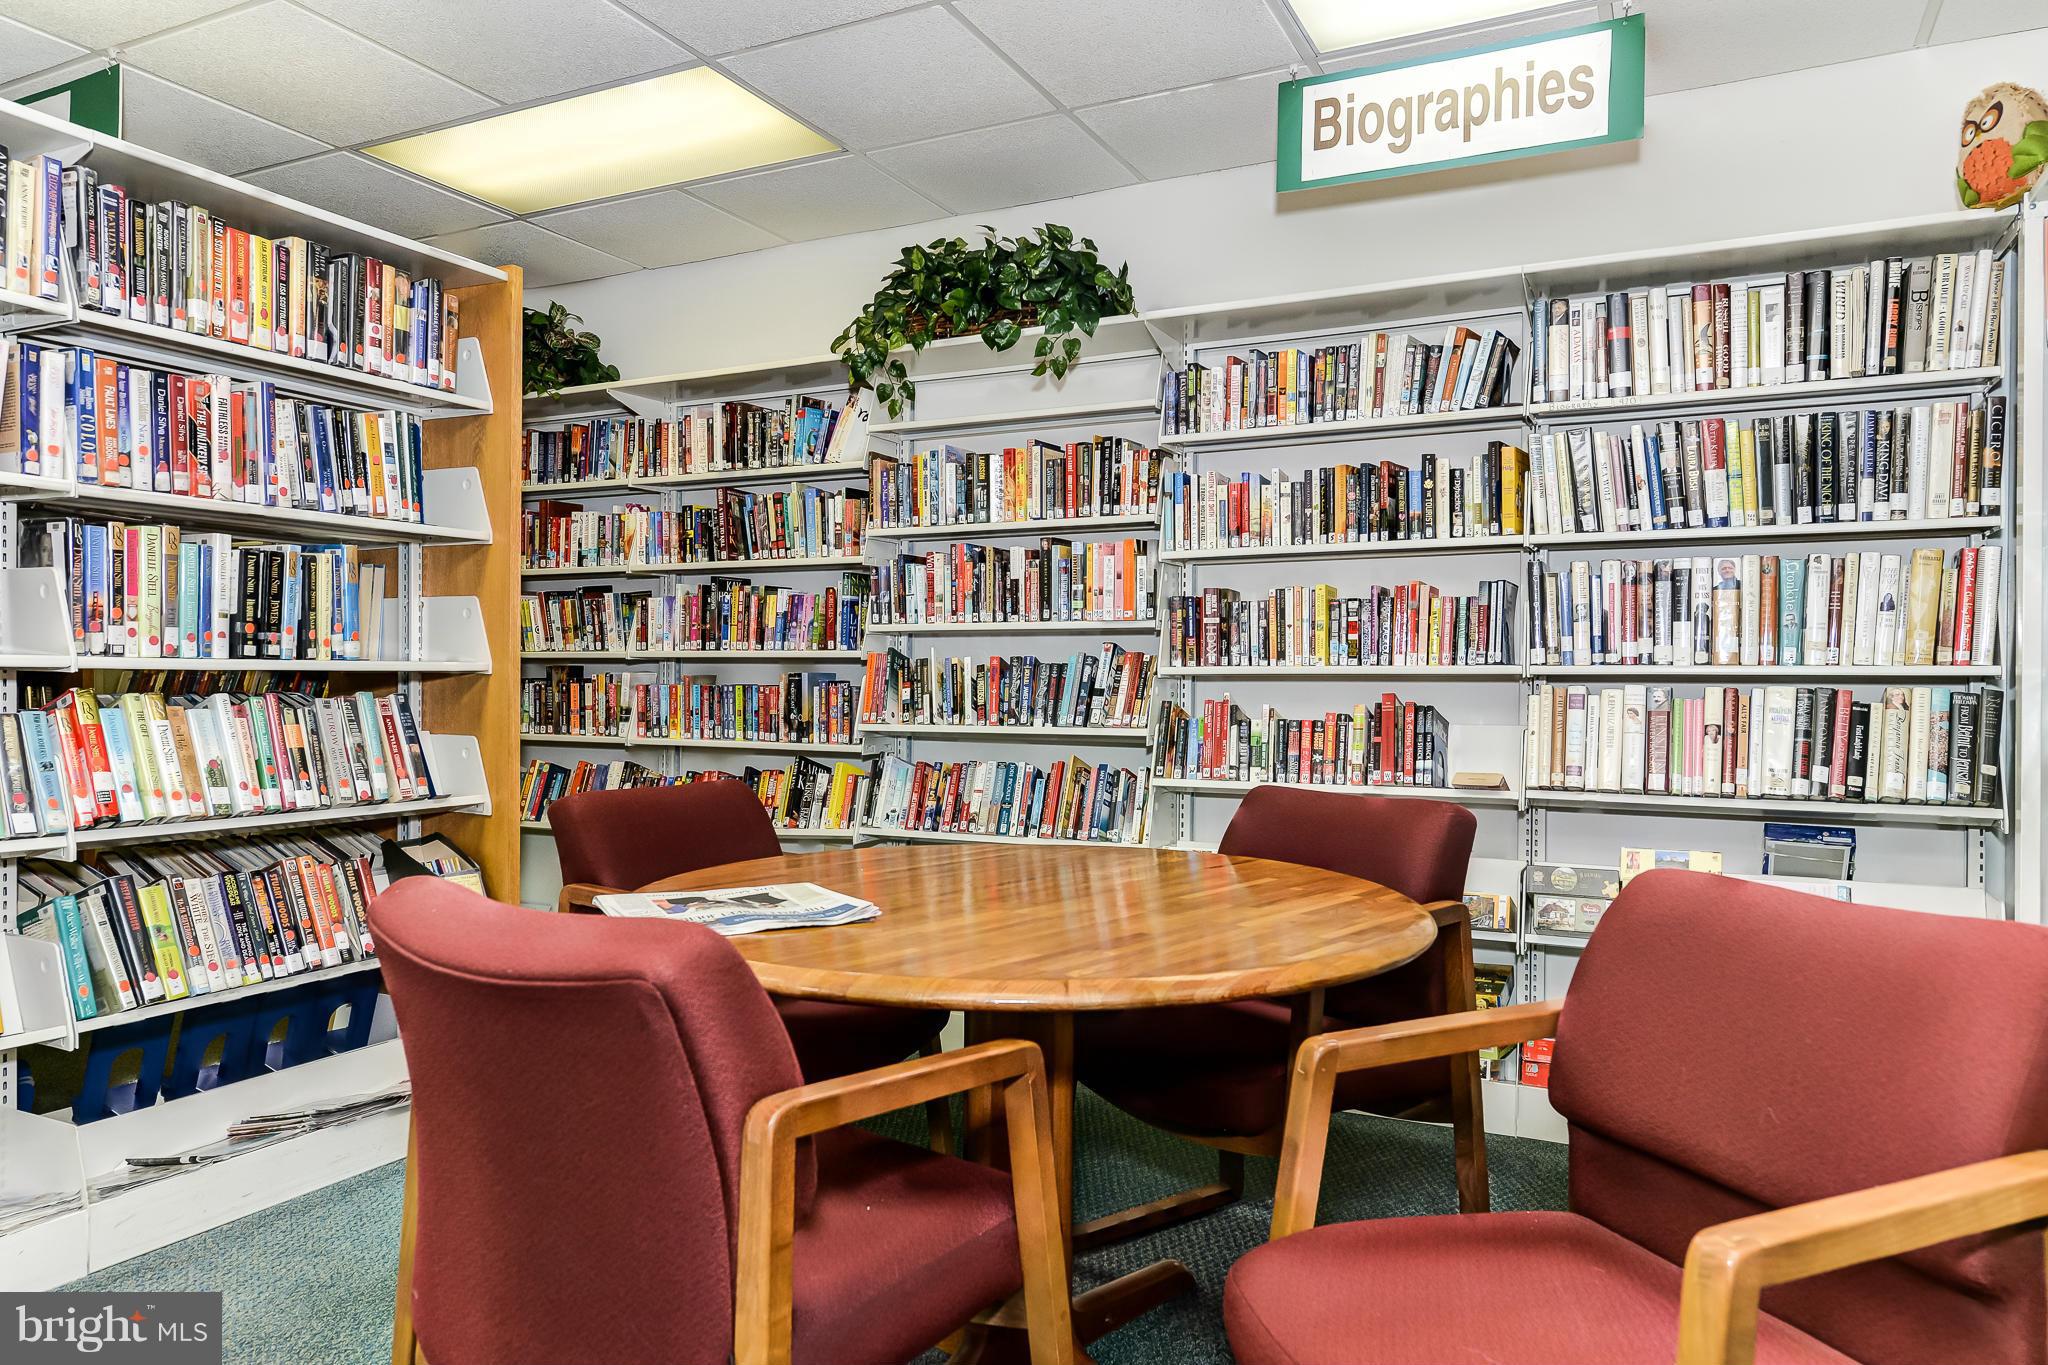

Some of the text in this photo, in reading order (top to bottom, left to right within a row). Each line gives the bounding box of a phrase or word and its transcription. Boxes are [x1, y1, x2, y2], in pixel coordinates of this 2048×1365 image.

[1313, 60, 1595, 154] Biographies
[214, 220, 224, 237] LISA
[1836, 280, 1846, 320] WIRED
[105, 384, 116, 430] FAULT LINES
[156, 388, 166, 435] Daniel Silva
[176, 396, 186, 442] Daniel Silva
[218, 397, 228, 434] FAITHLESS
[196, 409, 208, 464] THE UNLIKELY
[1866, 413, 1875, 473] JIMMY CARTER
[1990, 404, 2004, 462] CICERO
[978, 456, 986, 480] LARSSON
[1686, 445, 1700, 491] LAURA BUSH
[1820, 422, 1832, 507] KING OF THE NIGH
[1847, 460, 1856, 504] CARNEGIE
[1878, 440, 1890, 500] KING DAVI
[146, 533, 158, 598] DANIELLE STEEL
[1786, 562, 1800, 610] Cronkite
[136, 710, 150, 738] THE GIFT
[325, 712, 338, 746] TUROW
[386, 718, 398, 754] ANNE TYLER
[1892, 713, 1908, 748] Benjamin
[1958, 706, 1974, 758] FROM Beirut TO
[190, 893, 202, 924] WHITE
[269, 874, 289, 928] STUART WOODS
[292, 875, 304, 898] STUART
[344, 862, 365, 921] STUART WOODS
